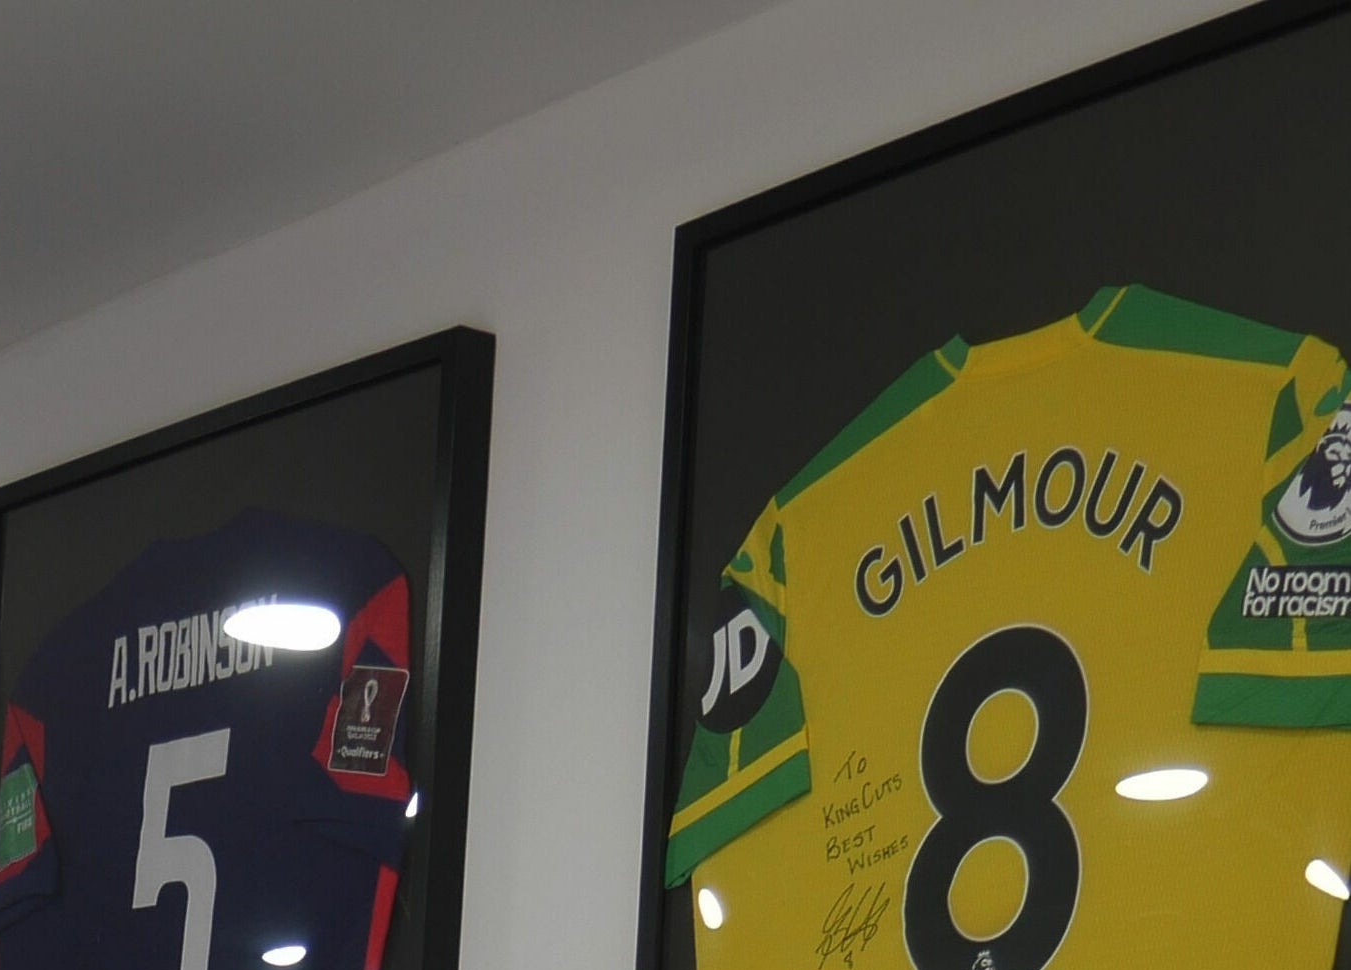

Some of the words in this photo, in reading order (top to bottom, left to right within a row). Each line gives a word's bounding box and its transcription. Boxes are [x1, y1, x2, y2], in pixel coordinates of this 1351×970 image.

[853, 445, 1184, 618] GILMOUR
[1243, 592, 1276, 616] for
[1247, 567, 1280, 593] No
[1282, 571, 1351, 594] room
[701, 608, 771, 717] JD
